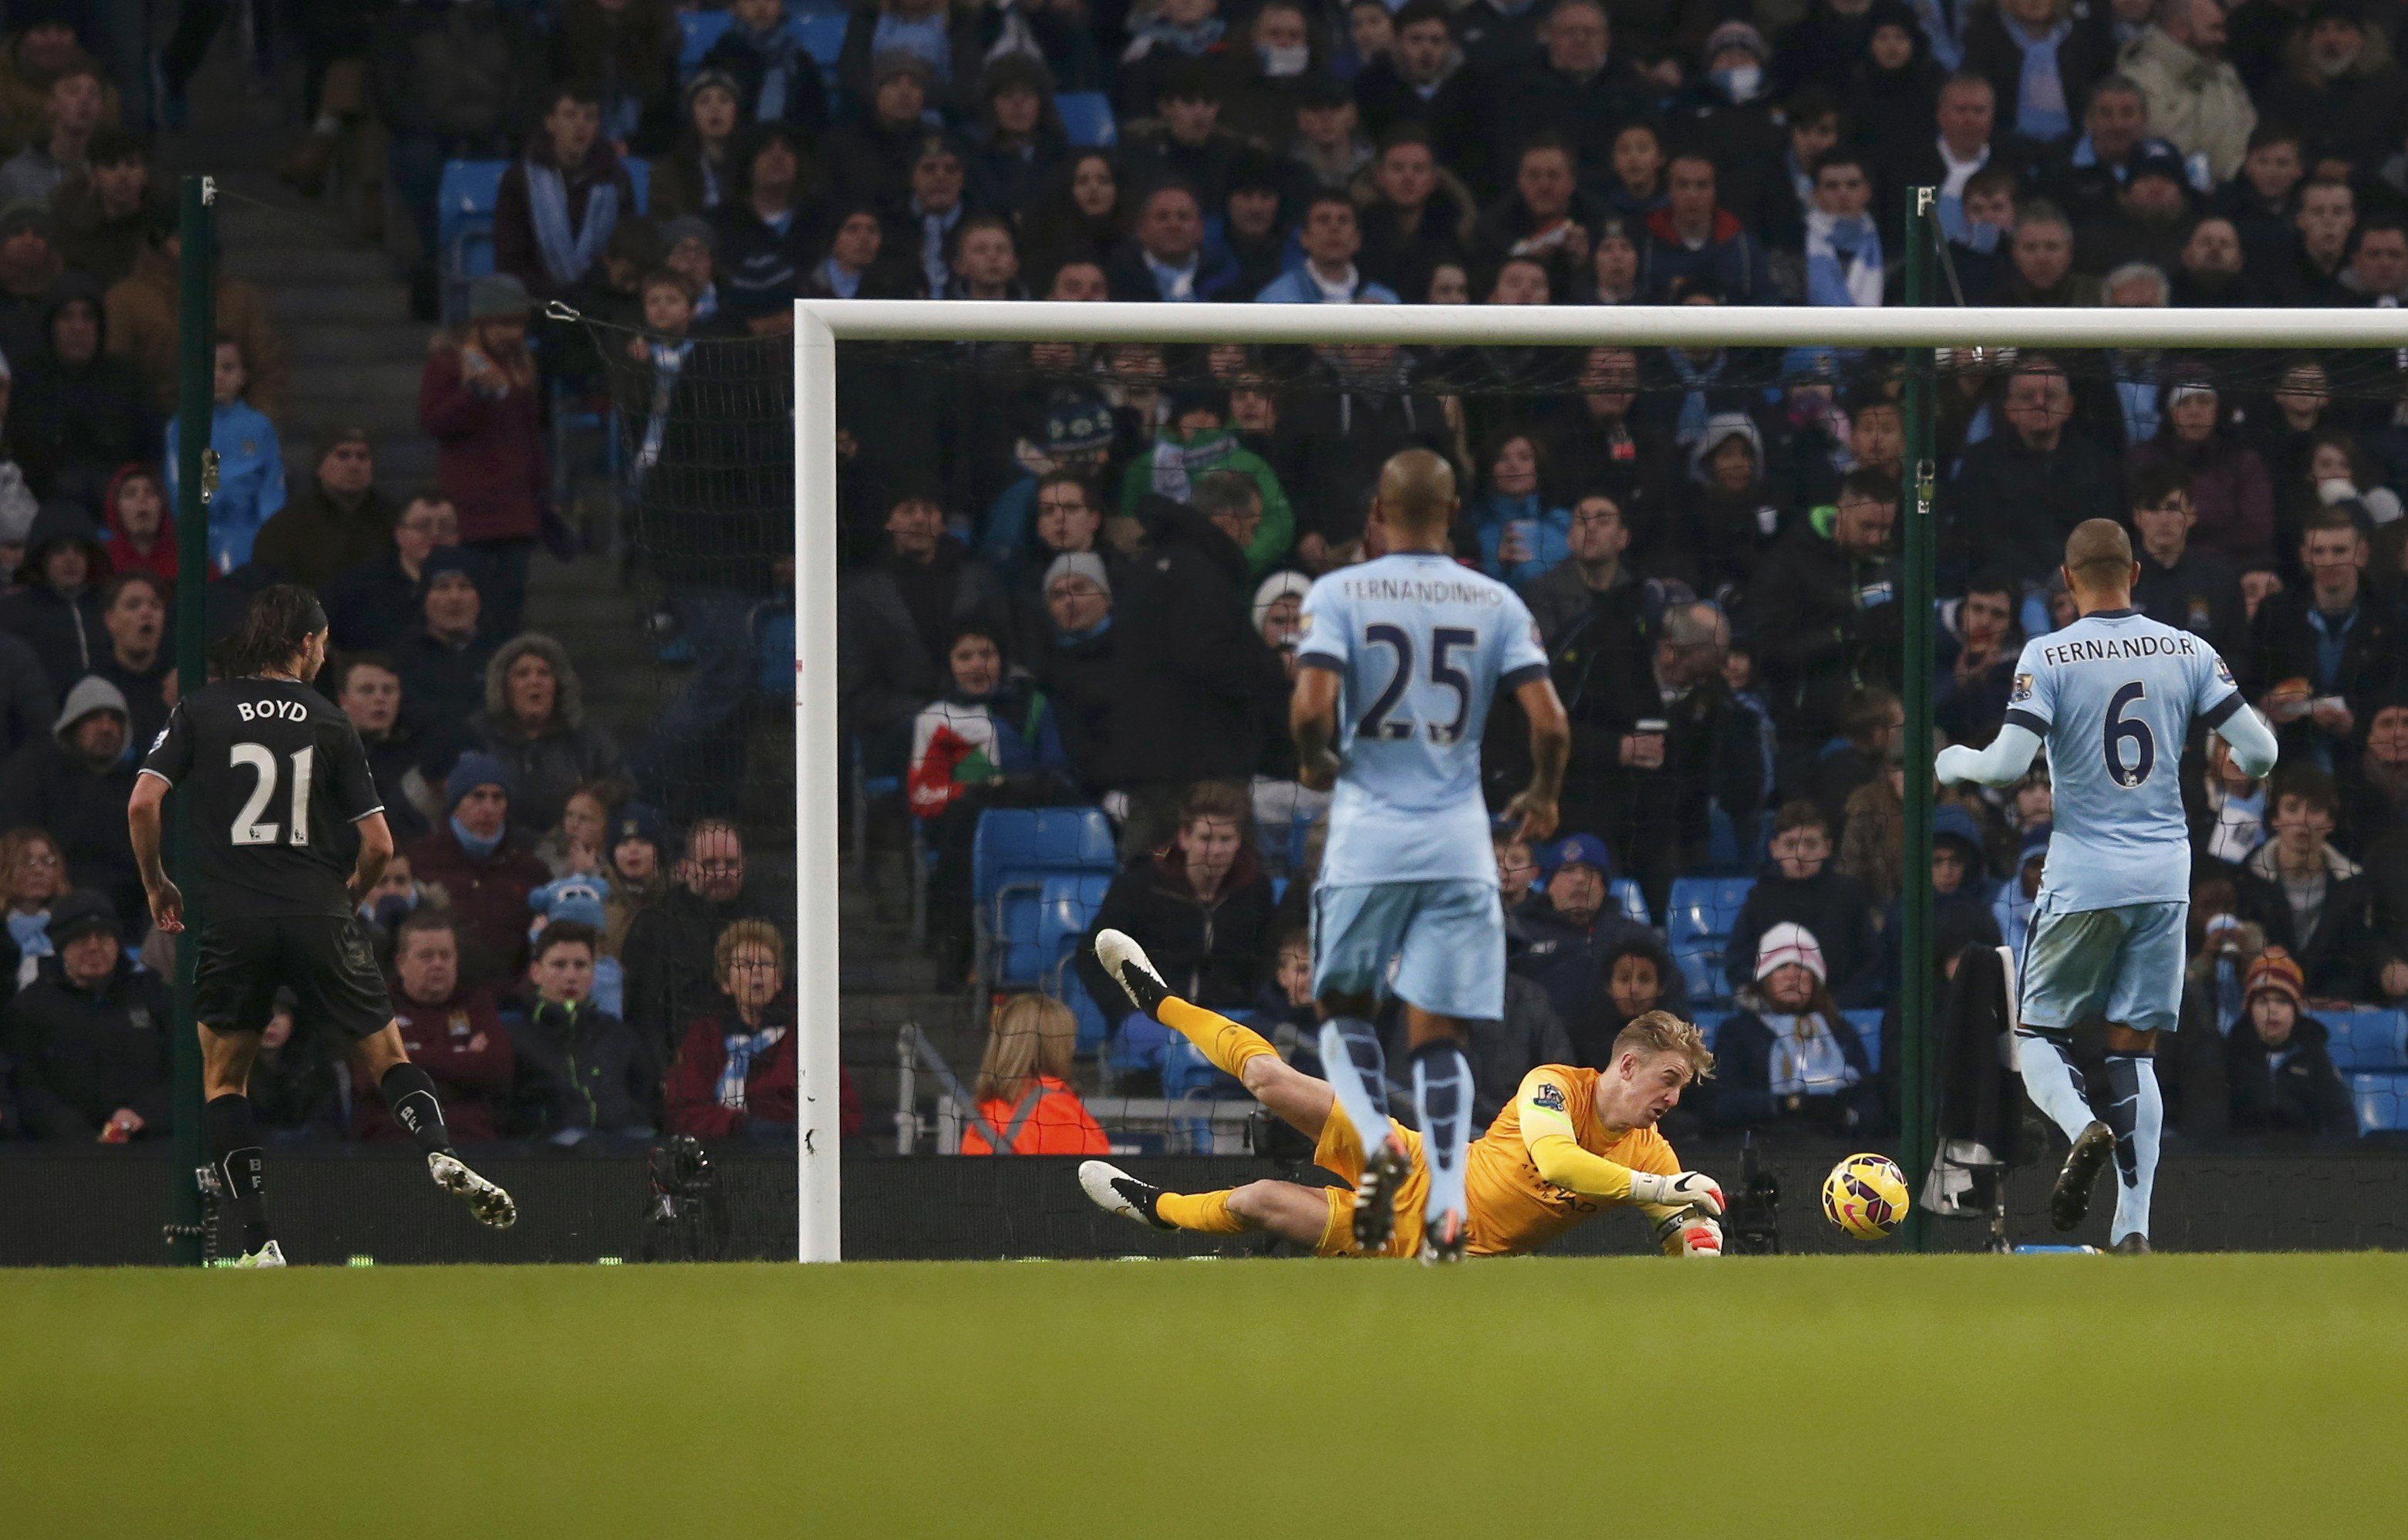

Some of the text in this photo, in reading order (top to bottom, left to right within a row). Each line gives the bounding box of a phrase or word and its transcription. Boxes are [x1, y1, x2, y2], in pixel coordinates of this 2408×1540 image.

[1344, 579, 1503, 606] FERNANDINHO
[1357, 622, 1479, 745] 25
[2044, 637, 2196, 666] FERNANDO.R
[237, 700, 308, 722] BOYD
[2103, 680, 2157, 789] 6
[231, 741, 314, 846] 21
